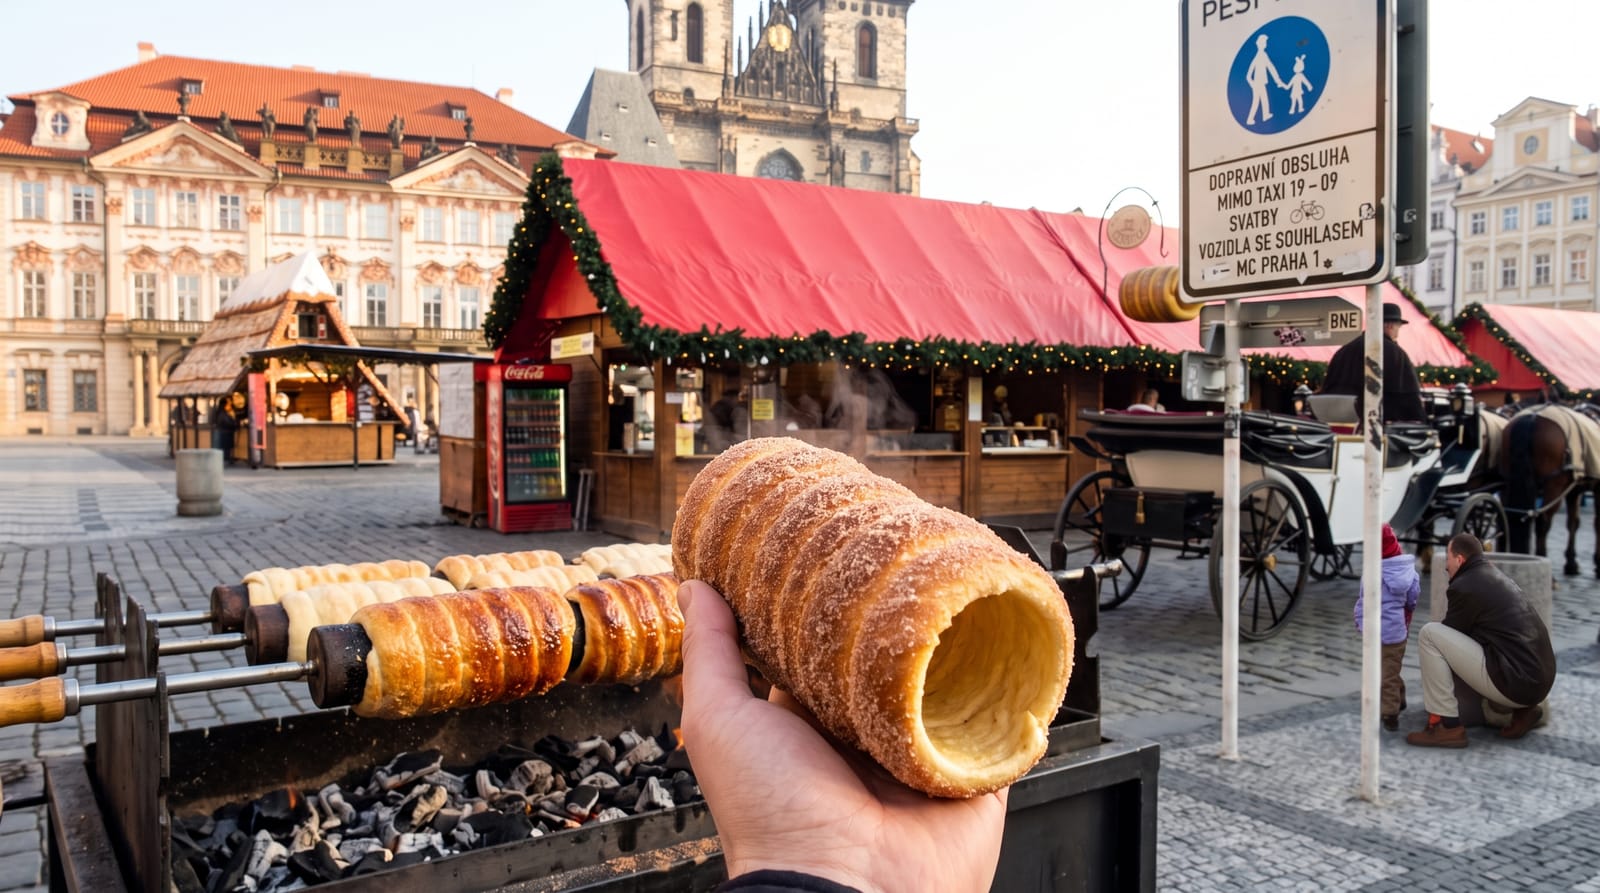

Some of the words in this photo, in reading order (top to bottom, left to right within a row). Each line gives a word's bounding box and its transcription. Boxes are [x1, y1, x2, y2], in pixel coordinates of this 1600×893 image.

[1209, 157, 1276, 191] DOPRAVNÍ
[1281, 145, 1350, 176] OBSLUHA
[1217, 189, 1252, 212] MIMO
[1256, 182, 1285, 204] TAXI
[1229, 207, 1279, 232] SVATBY
[1199, 237, 1251, 260] VOZIDLA
[1255, 233, 1271, 252] SE
[1275, 219, 1364, 249] SOUHLASEM
[1236, 259, 1256, 277] MC
[1261, 251, 1308, 274] PRAHA
[1313, 250, 1319, 268] 1
[1330, 312, 1357, 329] BNE
